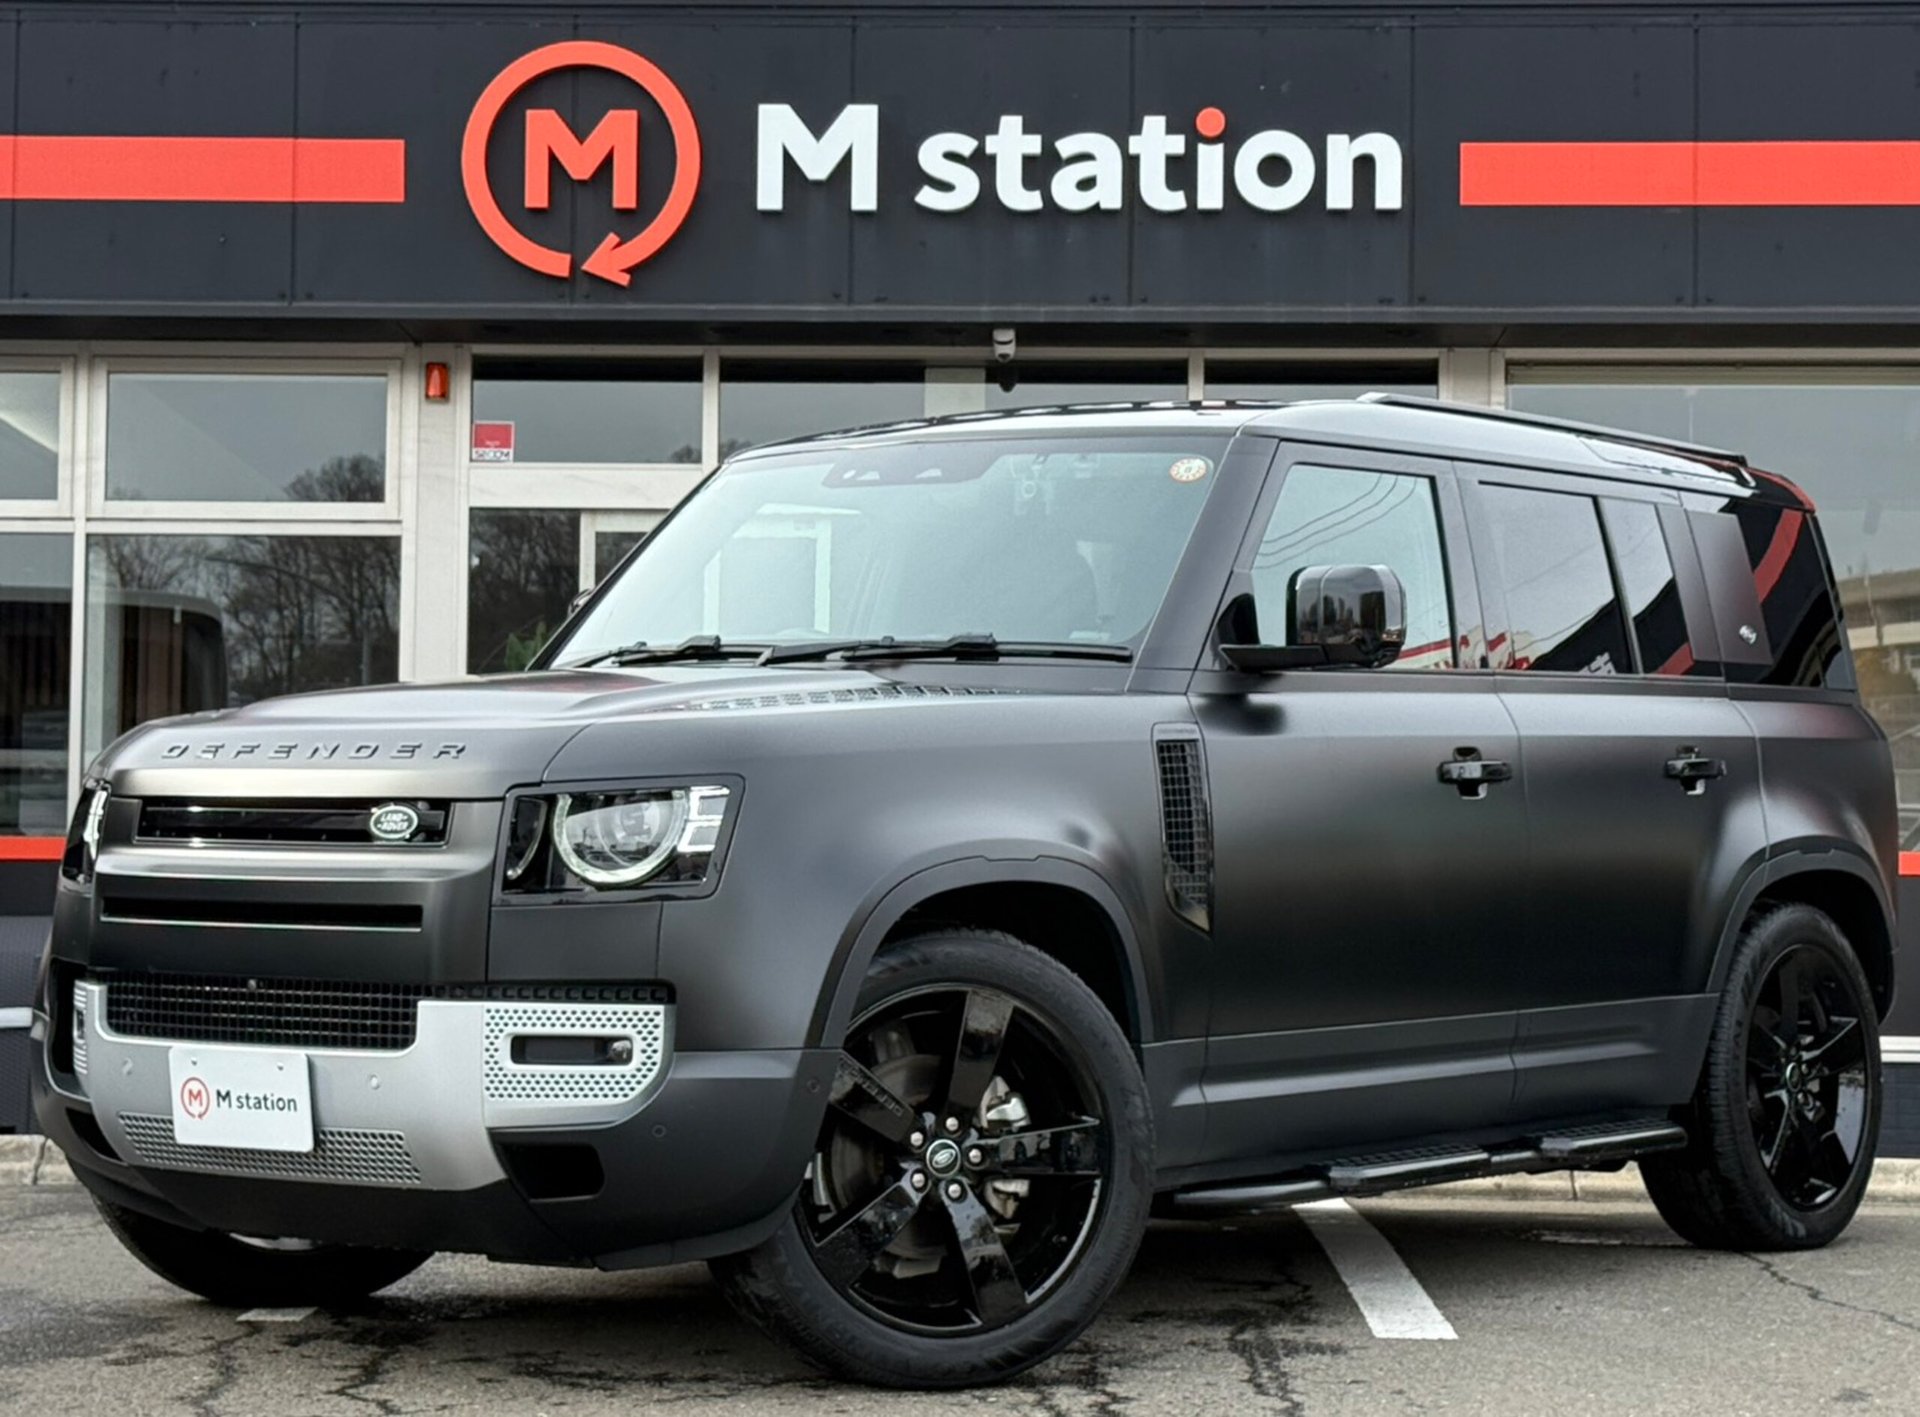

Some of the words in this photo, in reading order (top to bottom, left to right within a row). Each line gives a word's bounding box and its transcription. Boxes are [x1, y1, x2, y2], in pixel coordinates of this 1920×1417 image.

[524, 109, 638, 209] M
[757, 104, 879, 211] M
[914, 107, 1403, 212] station
[161, 743, 467, 760] DEFENDER
[188, 1088, 203, 1107] M
[216, 1089, 232, 1109] M
[236, 1093, 298, 1112] station
